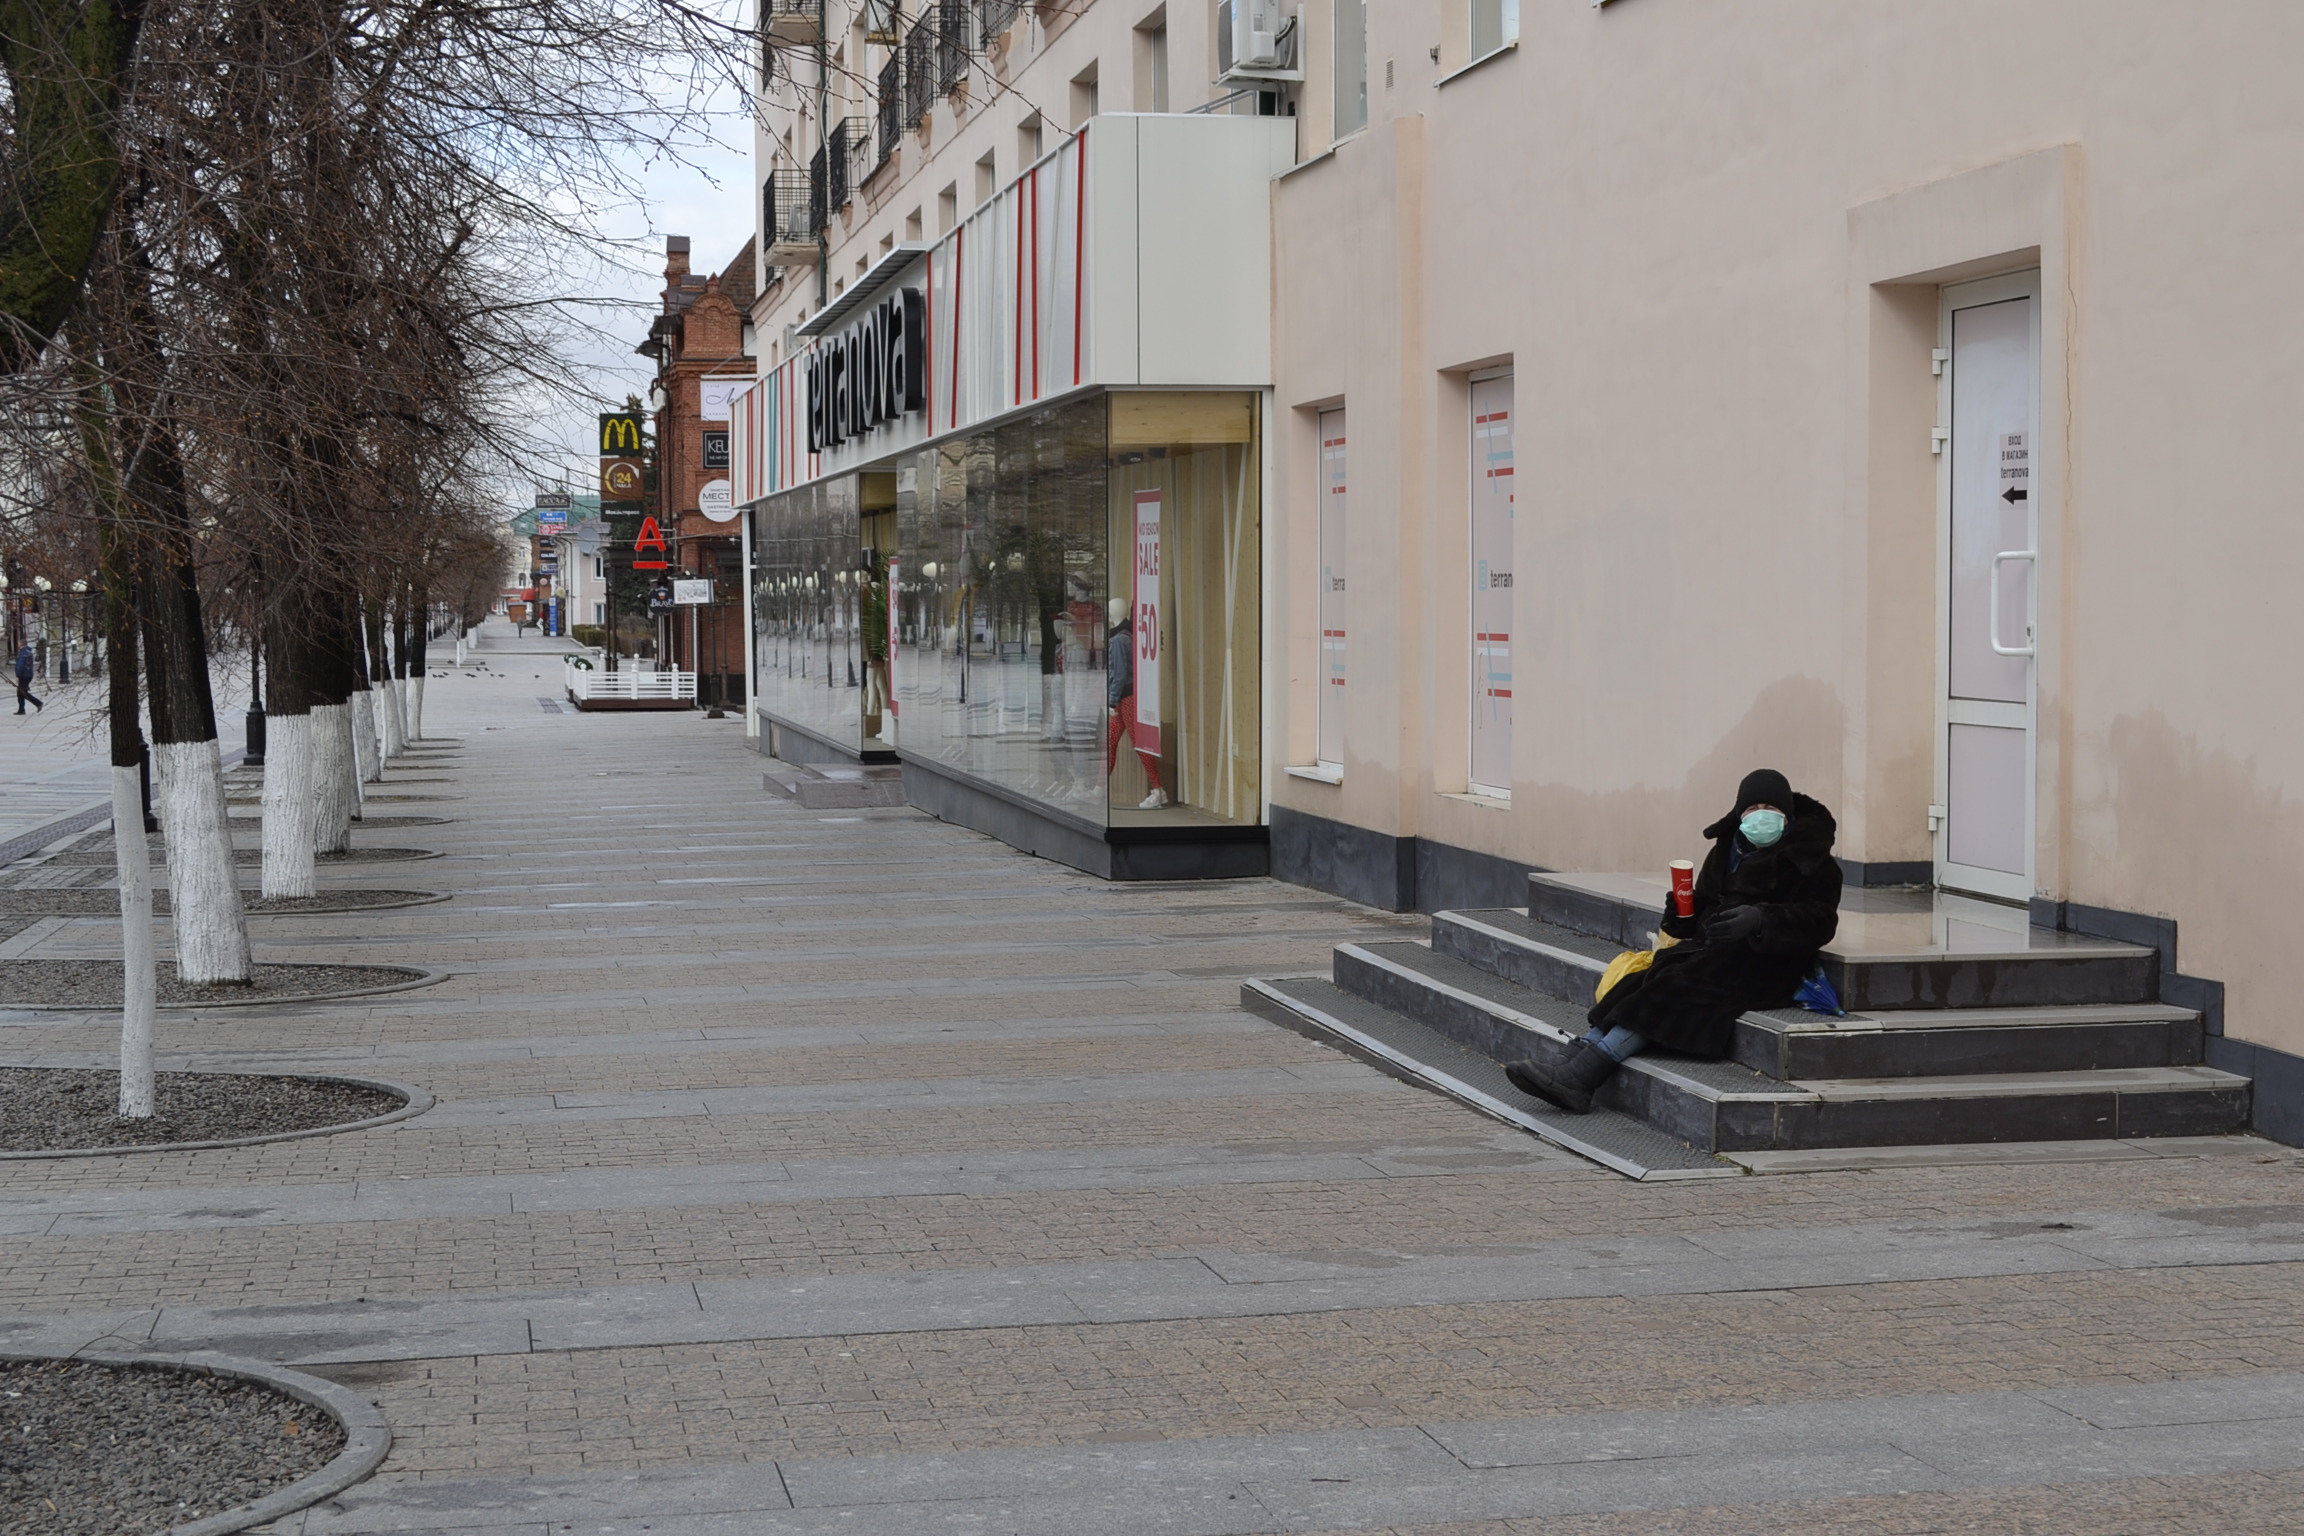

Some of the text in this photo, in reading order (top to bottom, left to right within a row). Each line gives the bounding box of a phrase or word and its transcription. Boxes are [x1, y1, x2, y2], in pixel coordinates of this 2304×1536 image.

[2008, 435, 2022, 446] ВХОД
[2006, 449, 2029, 460] МАГАЗИН
[616, 472, 632, 484] 24
[2001, 466, 2029, 479] terranova
[1139, 543, 1158, 576] SALE
[1490, 570, 1513, 588] terran
